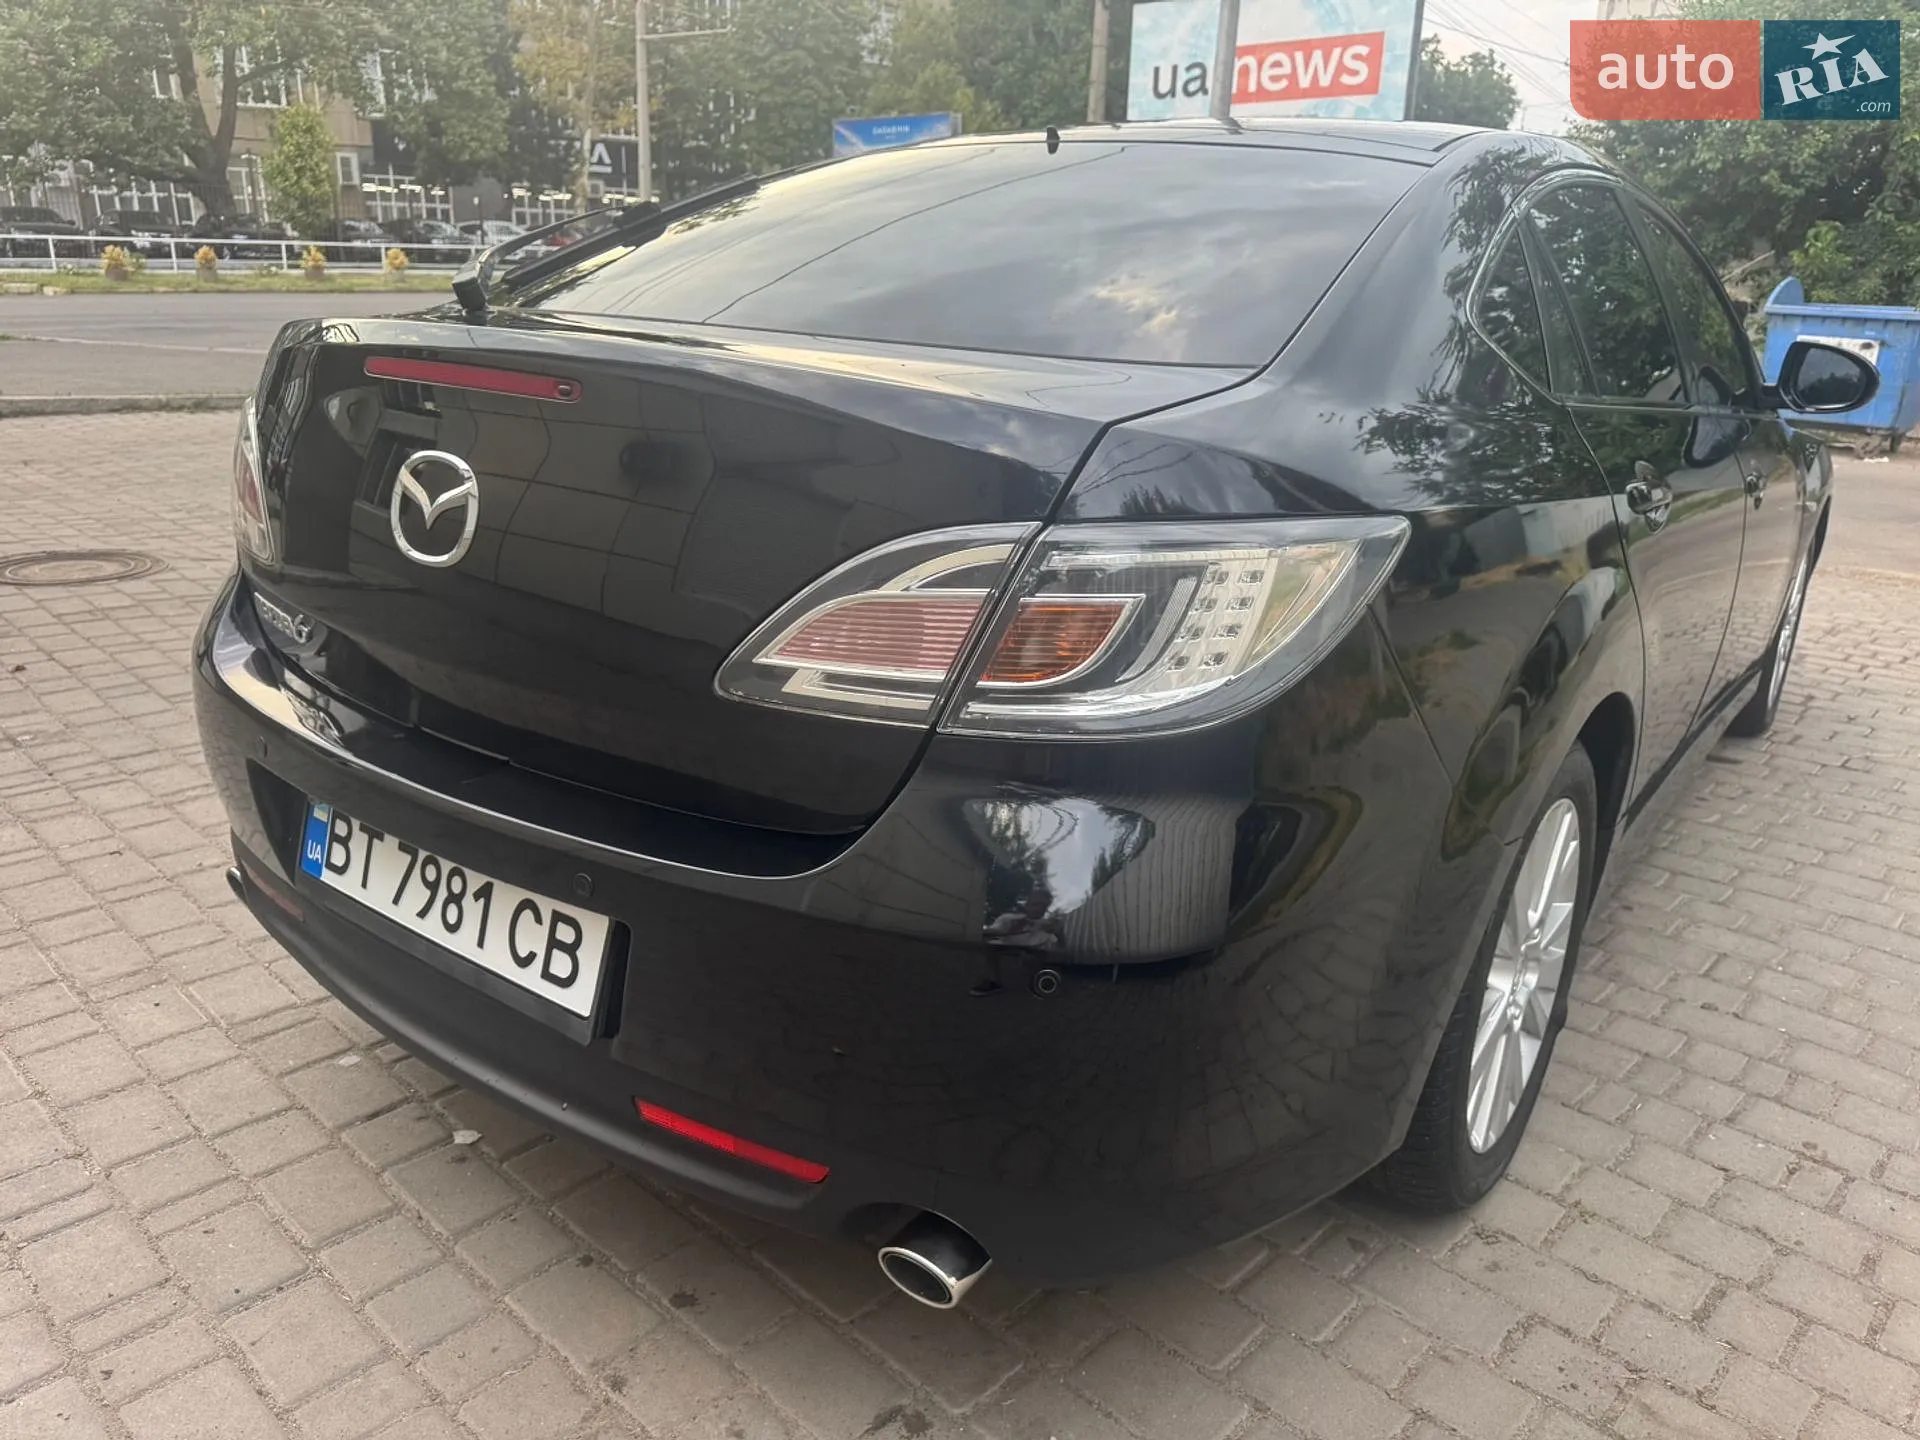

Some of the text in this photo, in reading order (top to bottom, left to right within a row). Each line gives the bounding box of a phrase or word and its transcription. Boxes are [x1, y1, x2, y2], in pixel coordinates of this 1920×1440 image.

[1152, 44, 1370, 99] ua news
[307, 839, 322, 864] UA
[325, 808, 583, 989] BT 7981 CB
